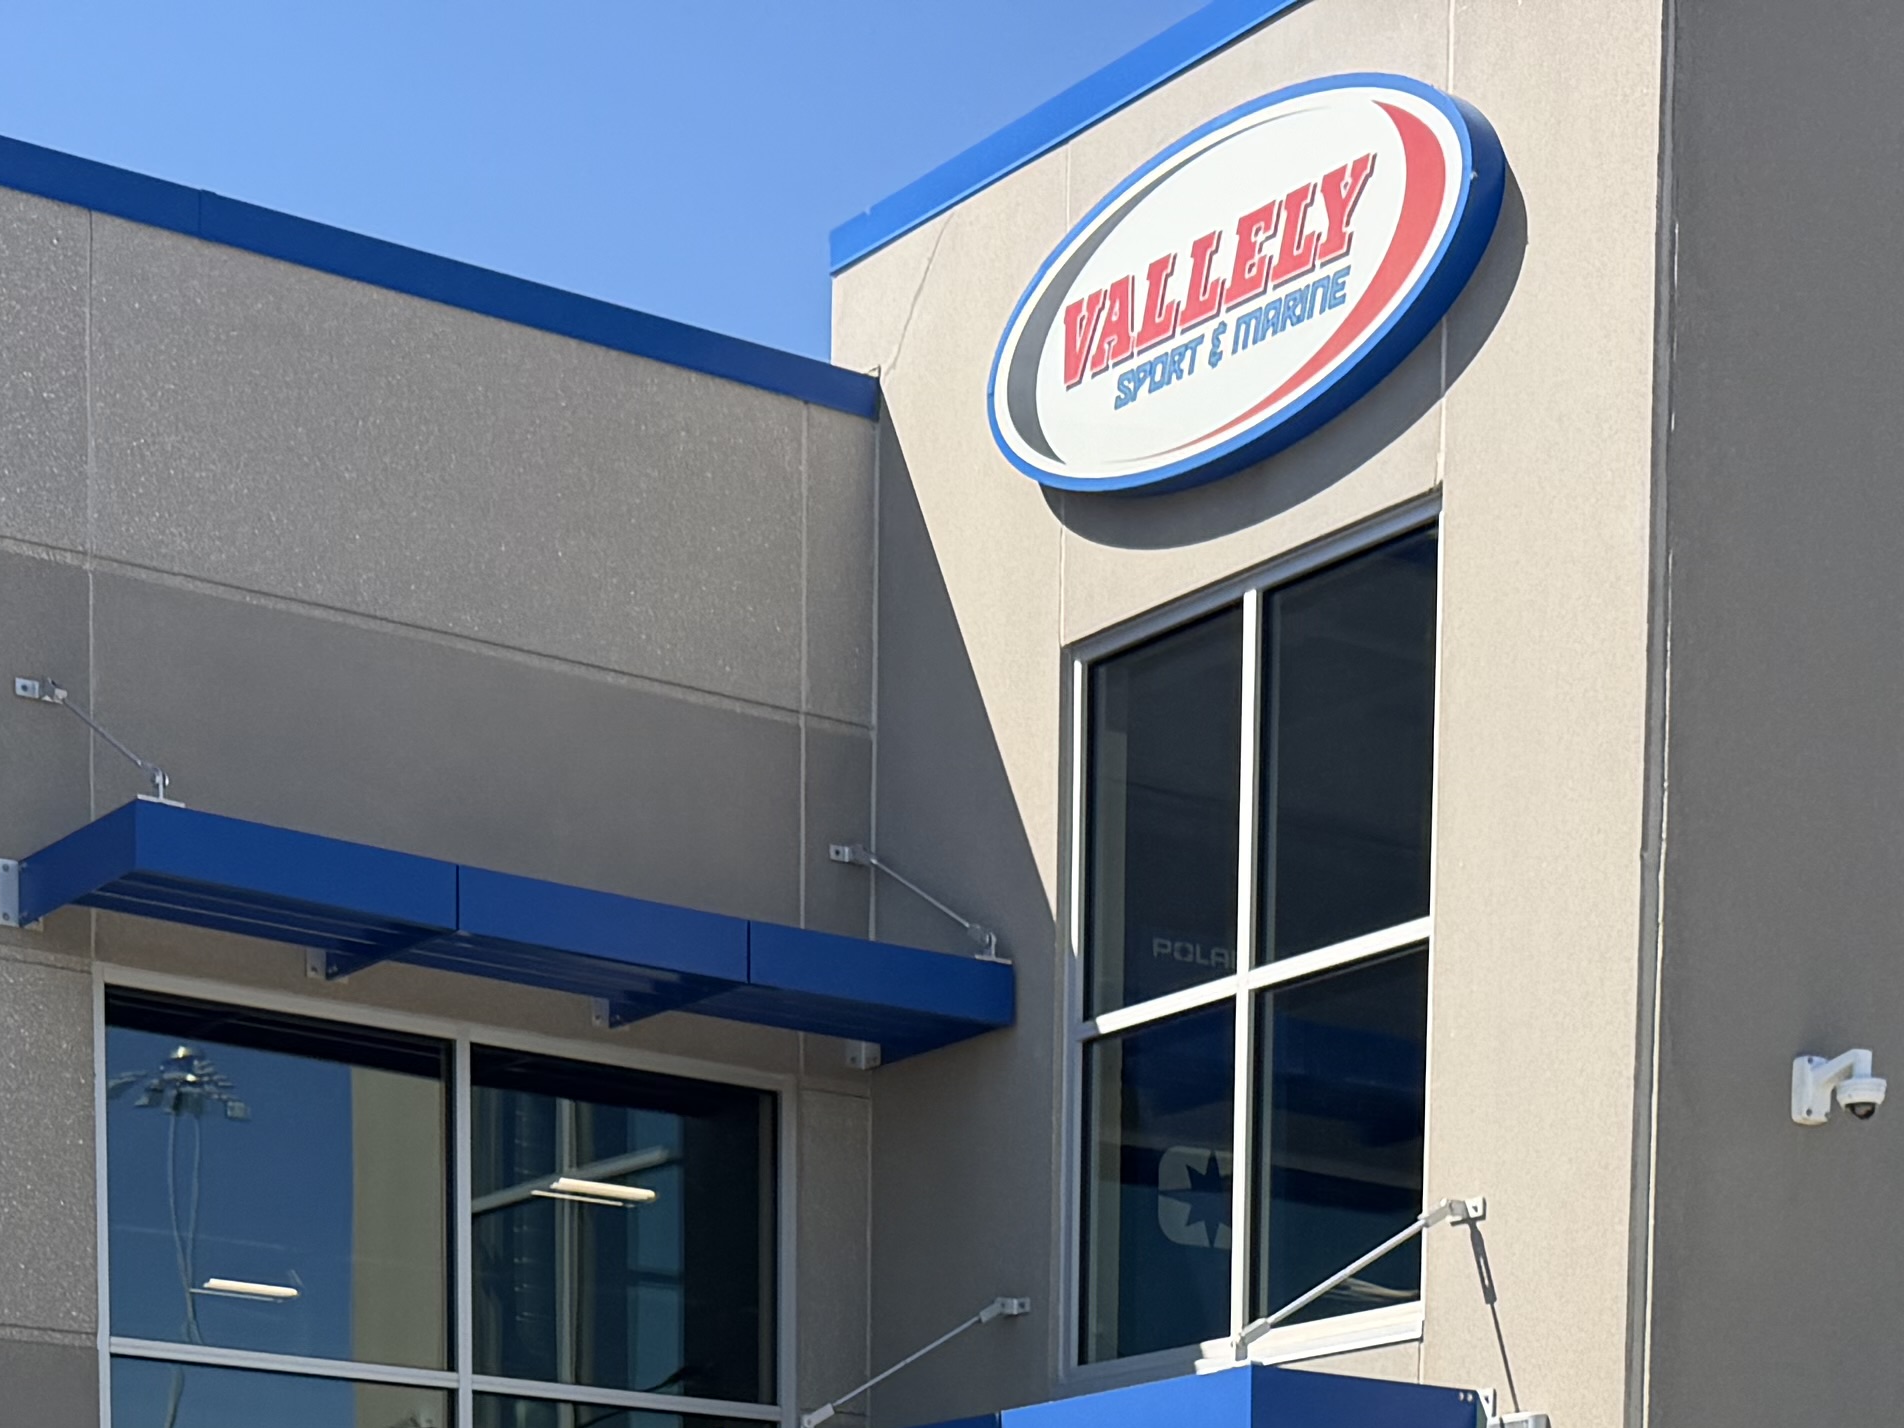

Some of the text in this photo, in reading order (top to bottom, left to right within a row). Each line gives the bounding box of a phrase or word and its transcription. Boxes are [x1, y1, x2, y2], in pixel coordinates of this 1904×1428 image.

[1063, 152, 1377, 391] VALLELY
[1114, 265, 1352, 410] SPORT & MARINE
